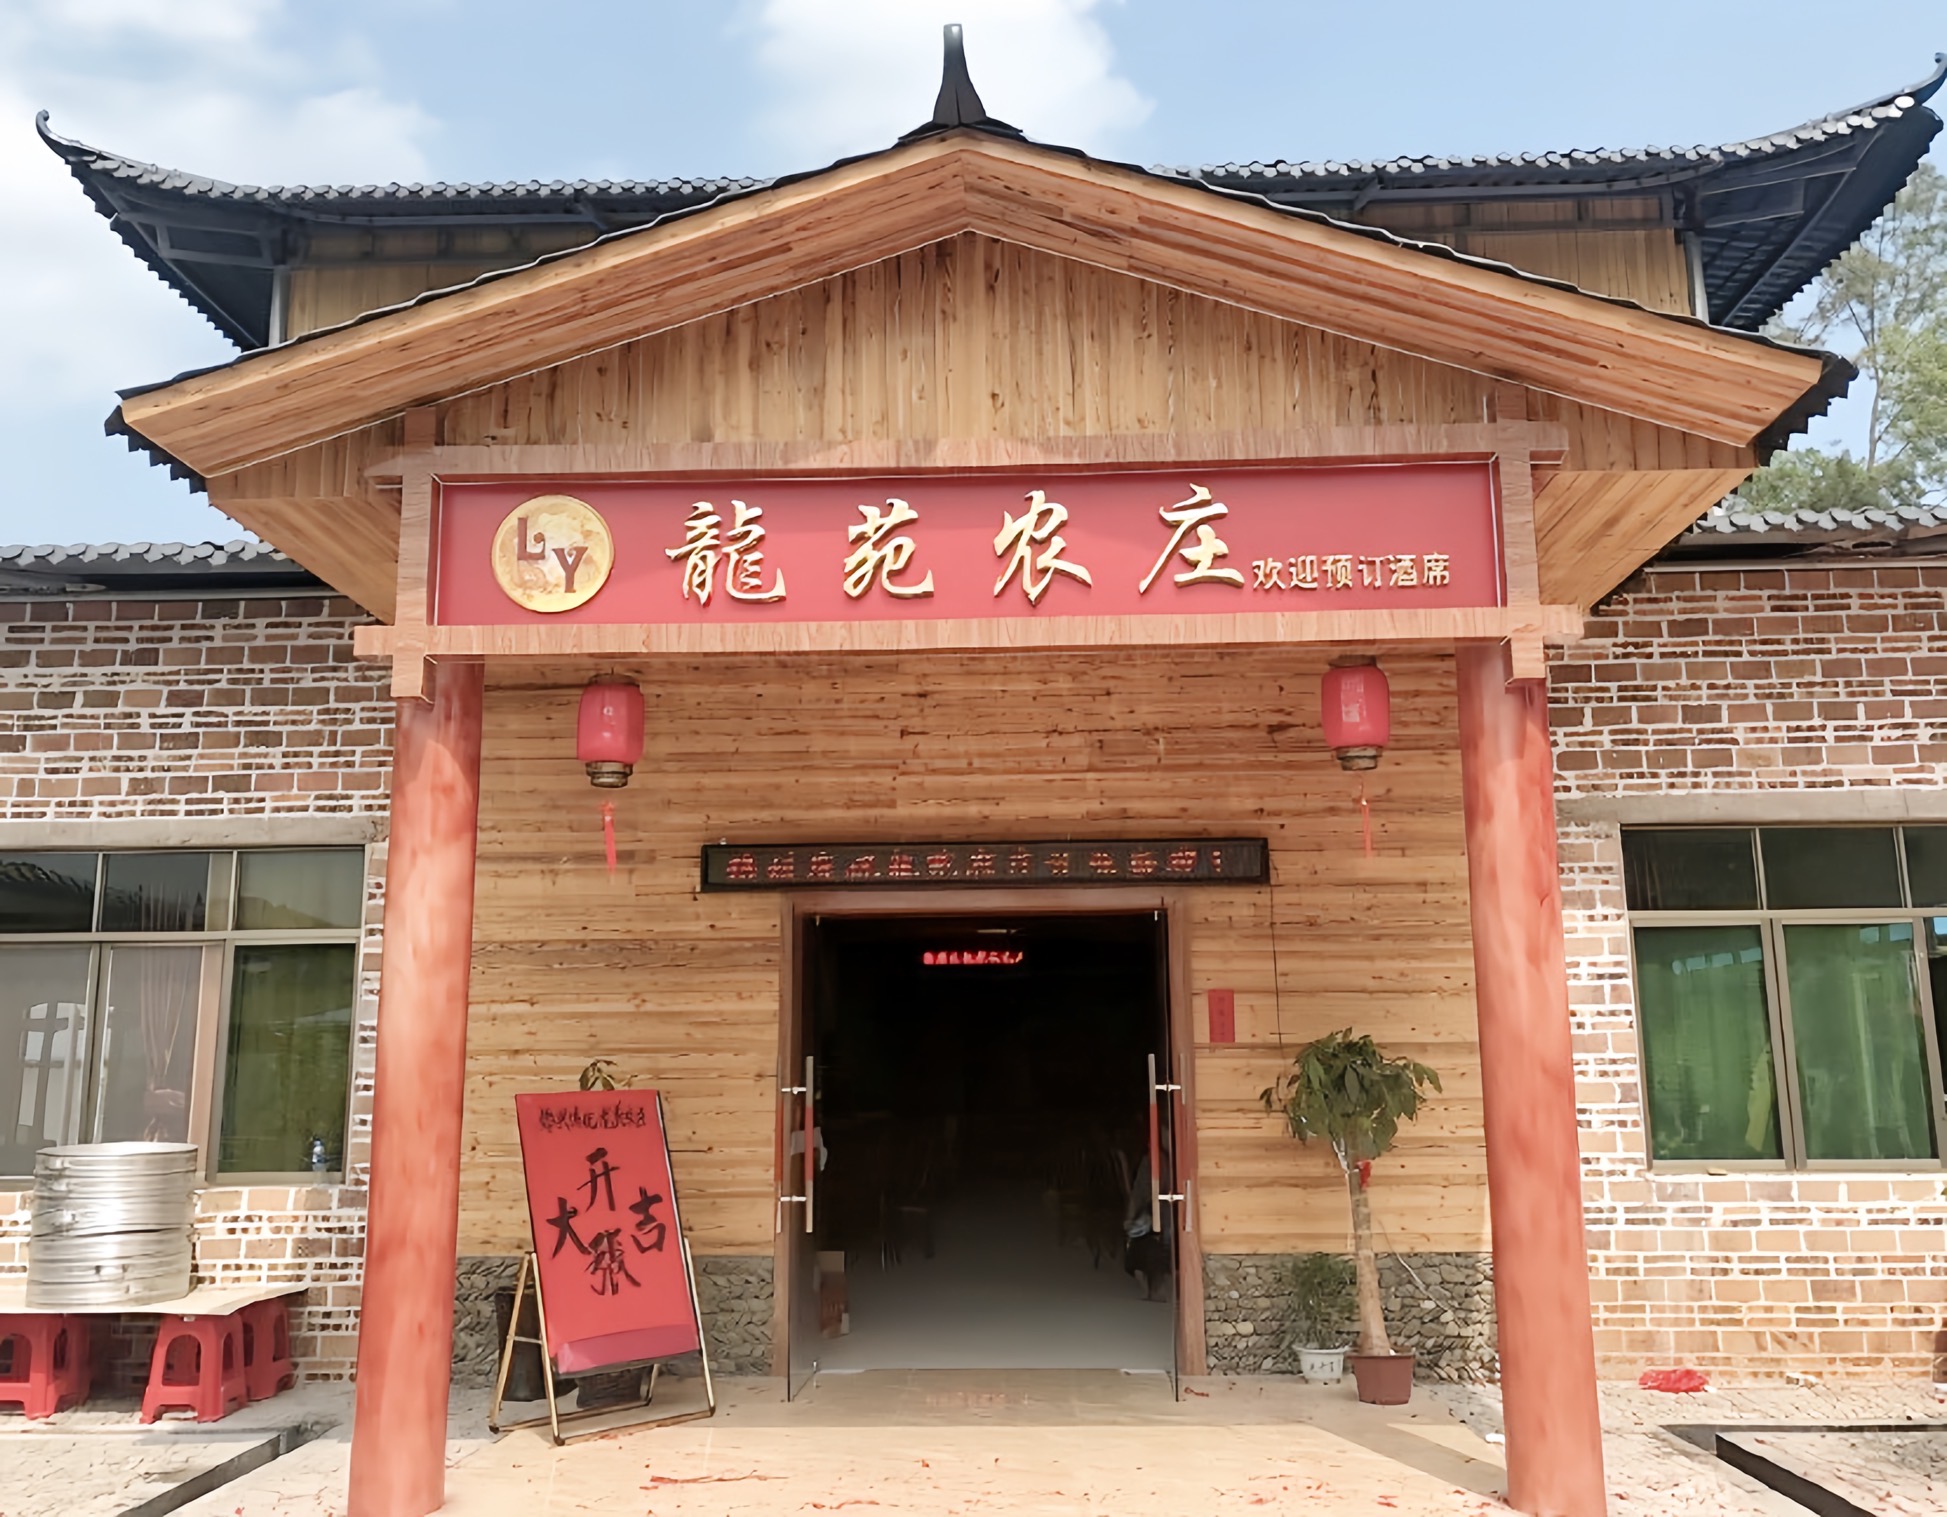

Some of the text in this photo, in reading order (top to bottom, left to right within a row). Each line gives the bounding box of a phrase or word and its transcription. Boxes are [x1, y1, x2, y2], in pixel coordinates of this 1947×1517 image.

[517, 516, 589, 594] LY
[1252, 551, 1450, 591] 欢迎预订酒席
